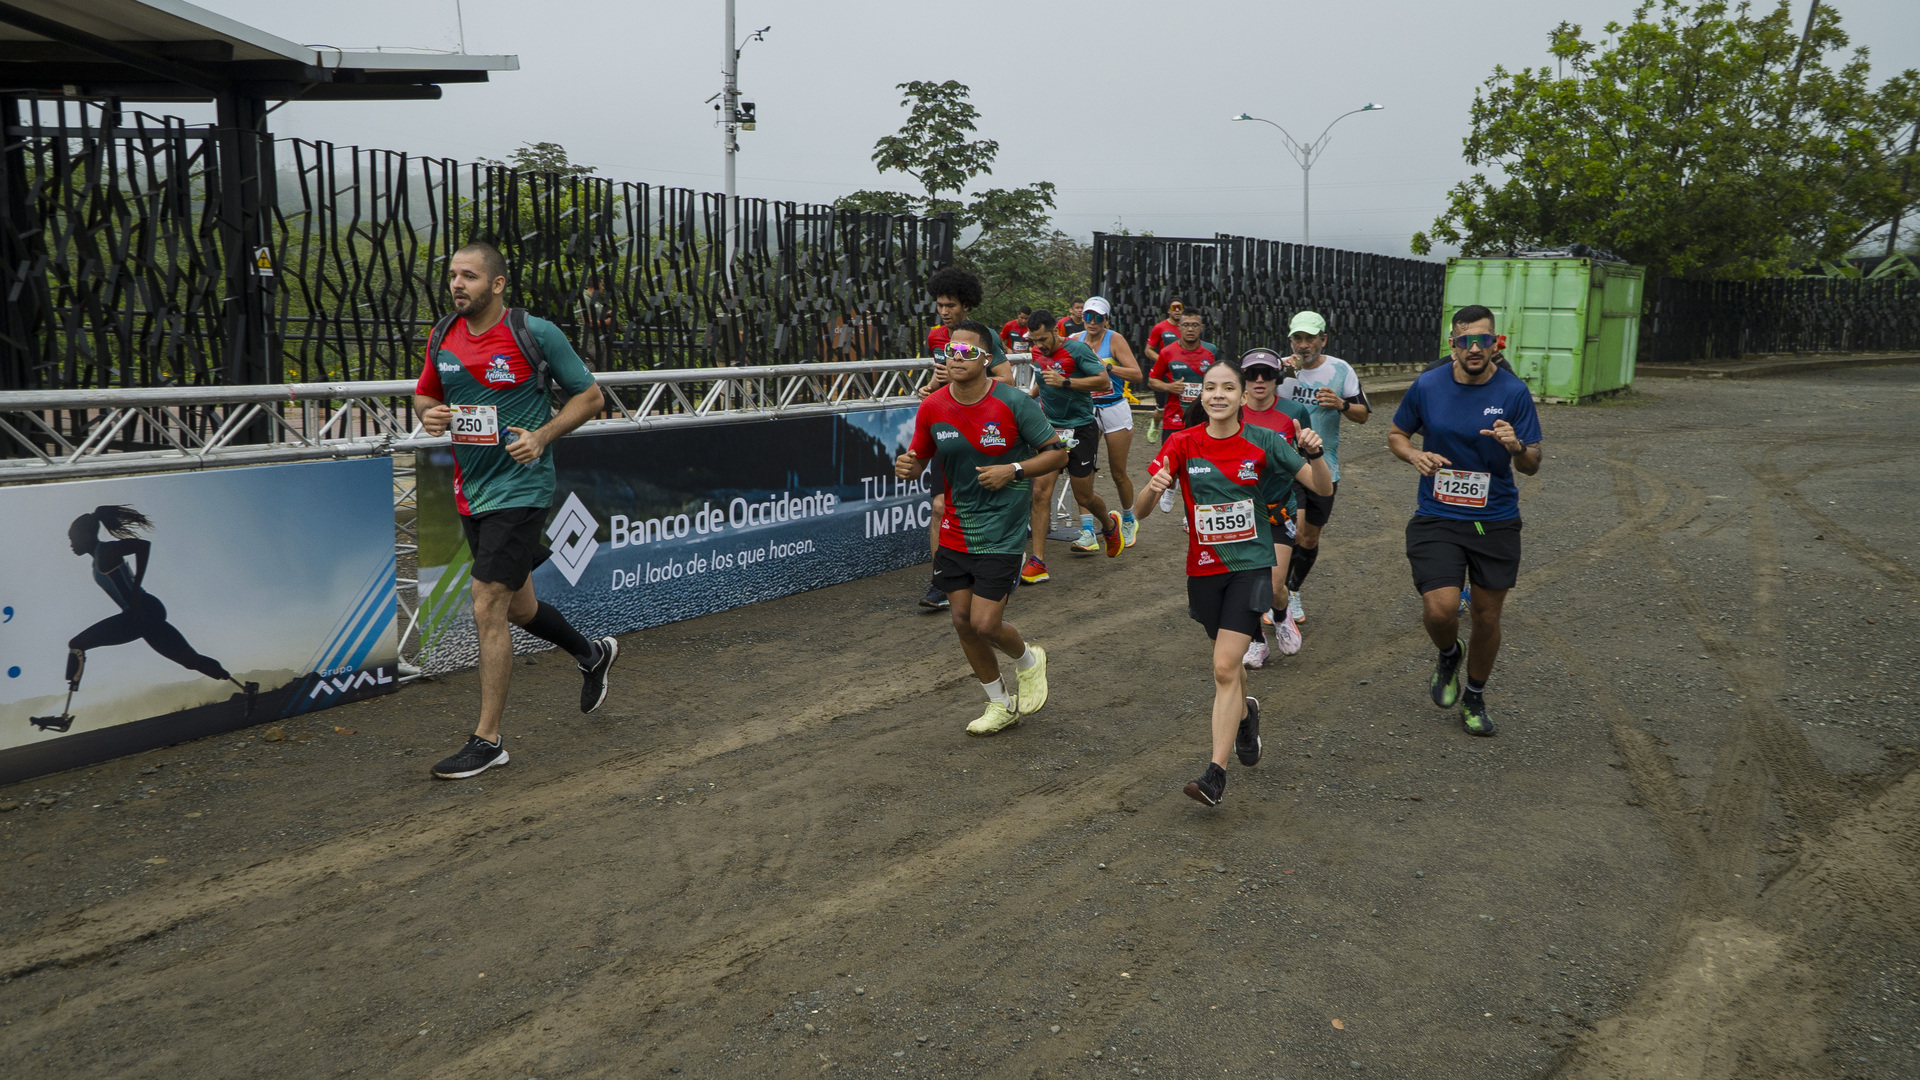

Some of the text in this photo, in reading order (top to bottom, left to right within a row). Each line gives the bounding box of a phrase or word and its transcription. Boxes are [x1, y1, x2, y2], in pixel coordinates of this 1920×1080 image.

[456, 417, 482, 432] 250
[860, 474, 887, 504] TU
[1443, 480, 1479, 496] 1256
[611, 490, 835, 549] Banco de Occidente
[1205, 514, 1246, 531] 1559
[611, 539, 816, 591] Del lado de los que hacen.
[320, 665, 353, 677] Grupo
[309, 667, 393, 699] AVAL
